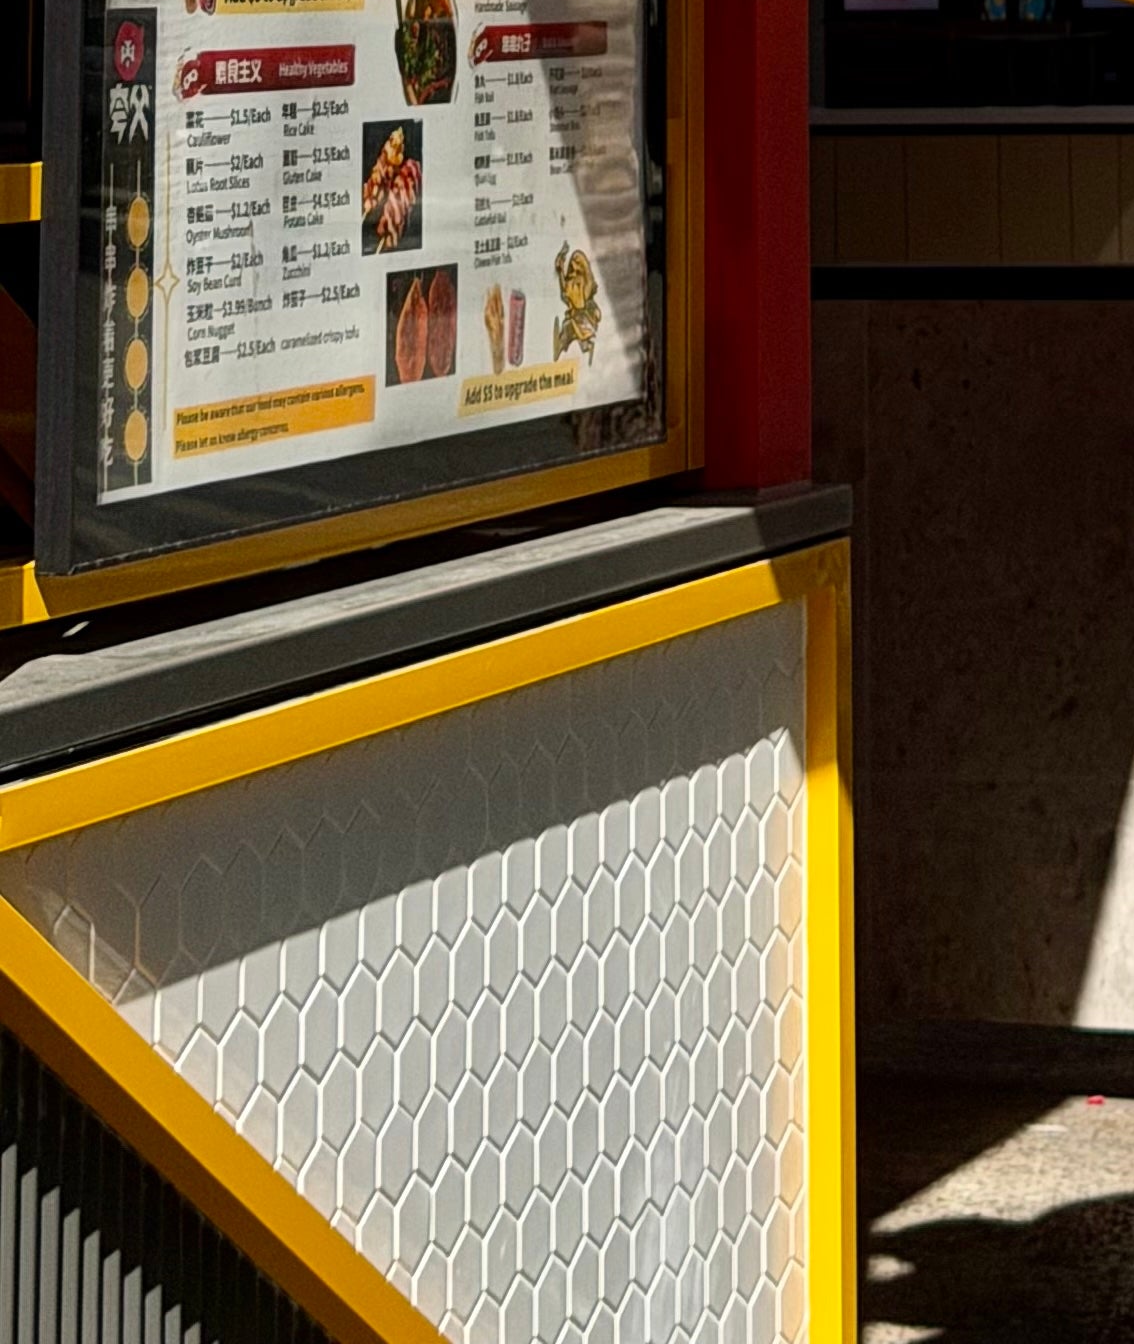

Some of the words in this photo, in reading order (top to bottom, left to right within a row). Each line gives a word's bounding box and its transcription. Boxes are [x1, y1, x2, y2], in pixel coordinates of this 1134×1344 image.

[279, 60, 308, 79] Healthy
[308, 58, 348, 79] Vegetables
[230, 107, 272, 126] $1.5/Each
[312, 99, 349, 118] $2.5/Each
[283, 124, 297, 137] Rice
[298, 123, 315, 136] Cake
[187, 131, 231, 148] Cauliflower
[230, 154, 264, 173] $2/Each
[312, 146, 350, 164] $2.5/Each
[186, 180, 208, 194] Lotus
[209, 178, 228, 193] Root
[229, 176, 250, 189] Slices
[231, 198, 271, 220] $1.2/Each
[313, 192, 350, 211] $4.5/Each
[307, 214, 324, 226] Cake
[186, 229, 212, 246] Oyster
[213, 225, 252, 241] Mushroom
[230, 252, 264, 270] $2/Each
[282, 265, 312, 281] Zucchini
[187, 280, 202, 294] Soy
[203, 277, 223, 292] Bean
[224, 275, 242, 289] Curd
[187, 326, 207, 341] Corn
[208, 323, 236, 341] Nugget
[323, 329, 344, 345] crispy
[465, 385, 482, 406] Add
[483, 383, 493, 403] $5
[494, 384, 503, 400] to
[504, 374, 537, 401] upgrade
[539, 372, 553, 391] the
[553, 368, 574, 388] meal
[176, 412, 199, 426] Please
[175, 439, 198, 455] Please
